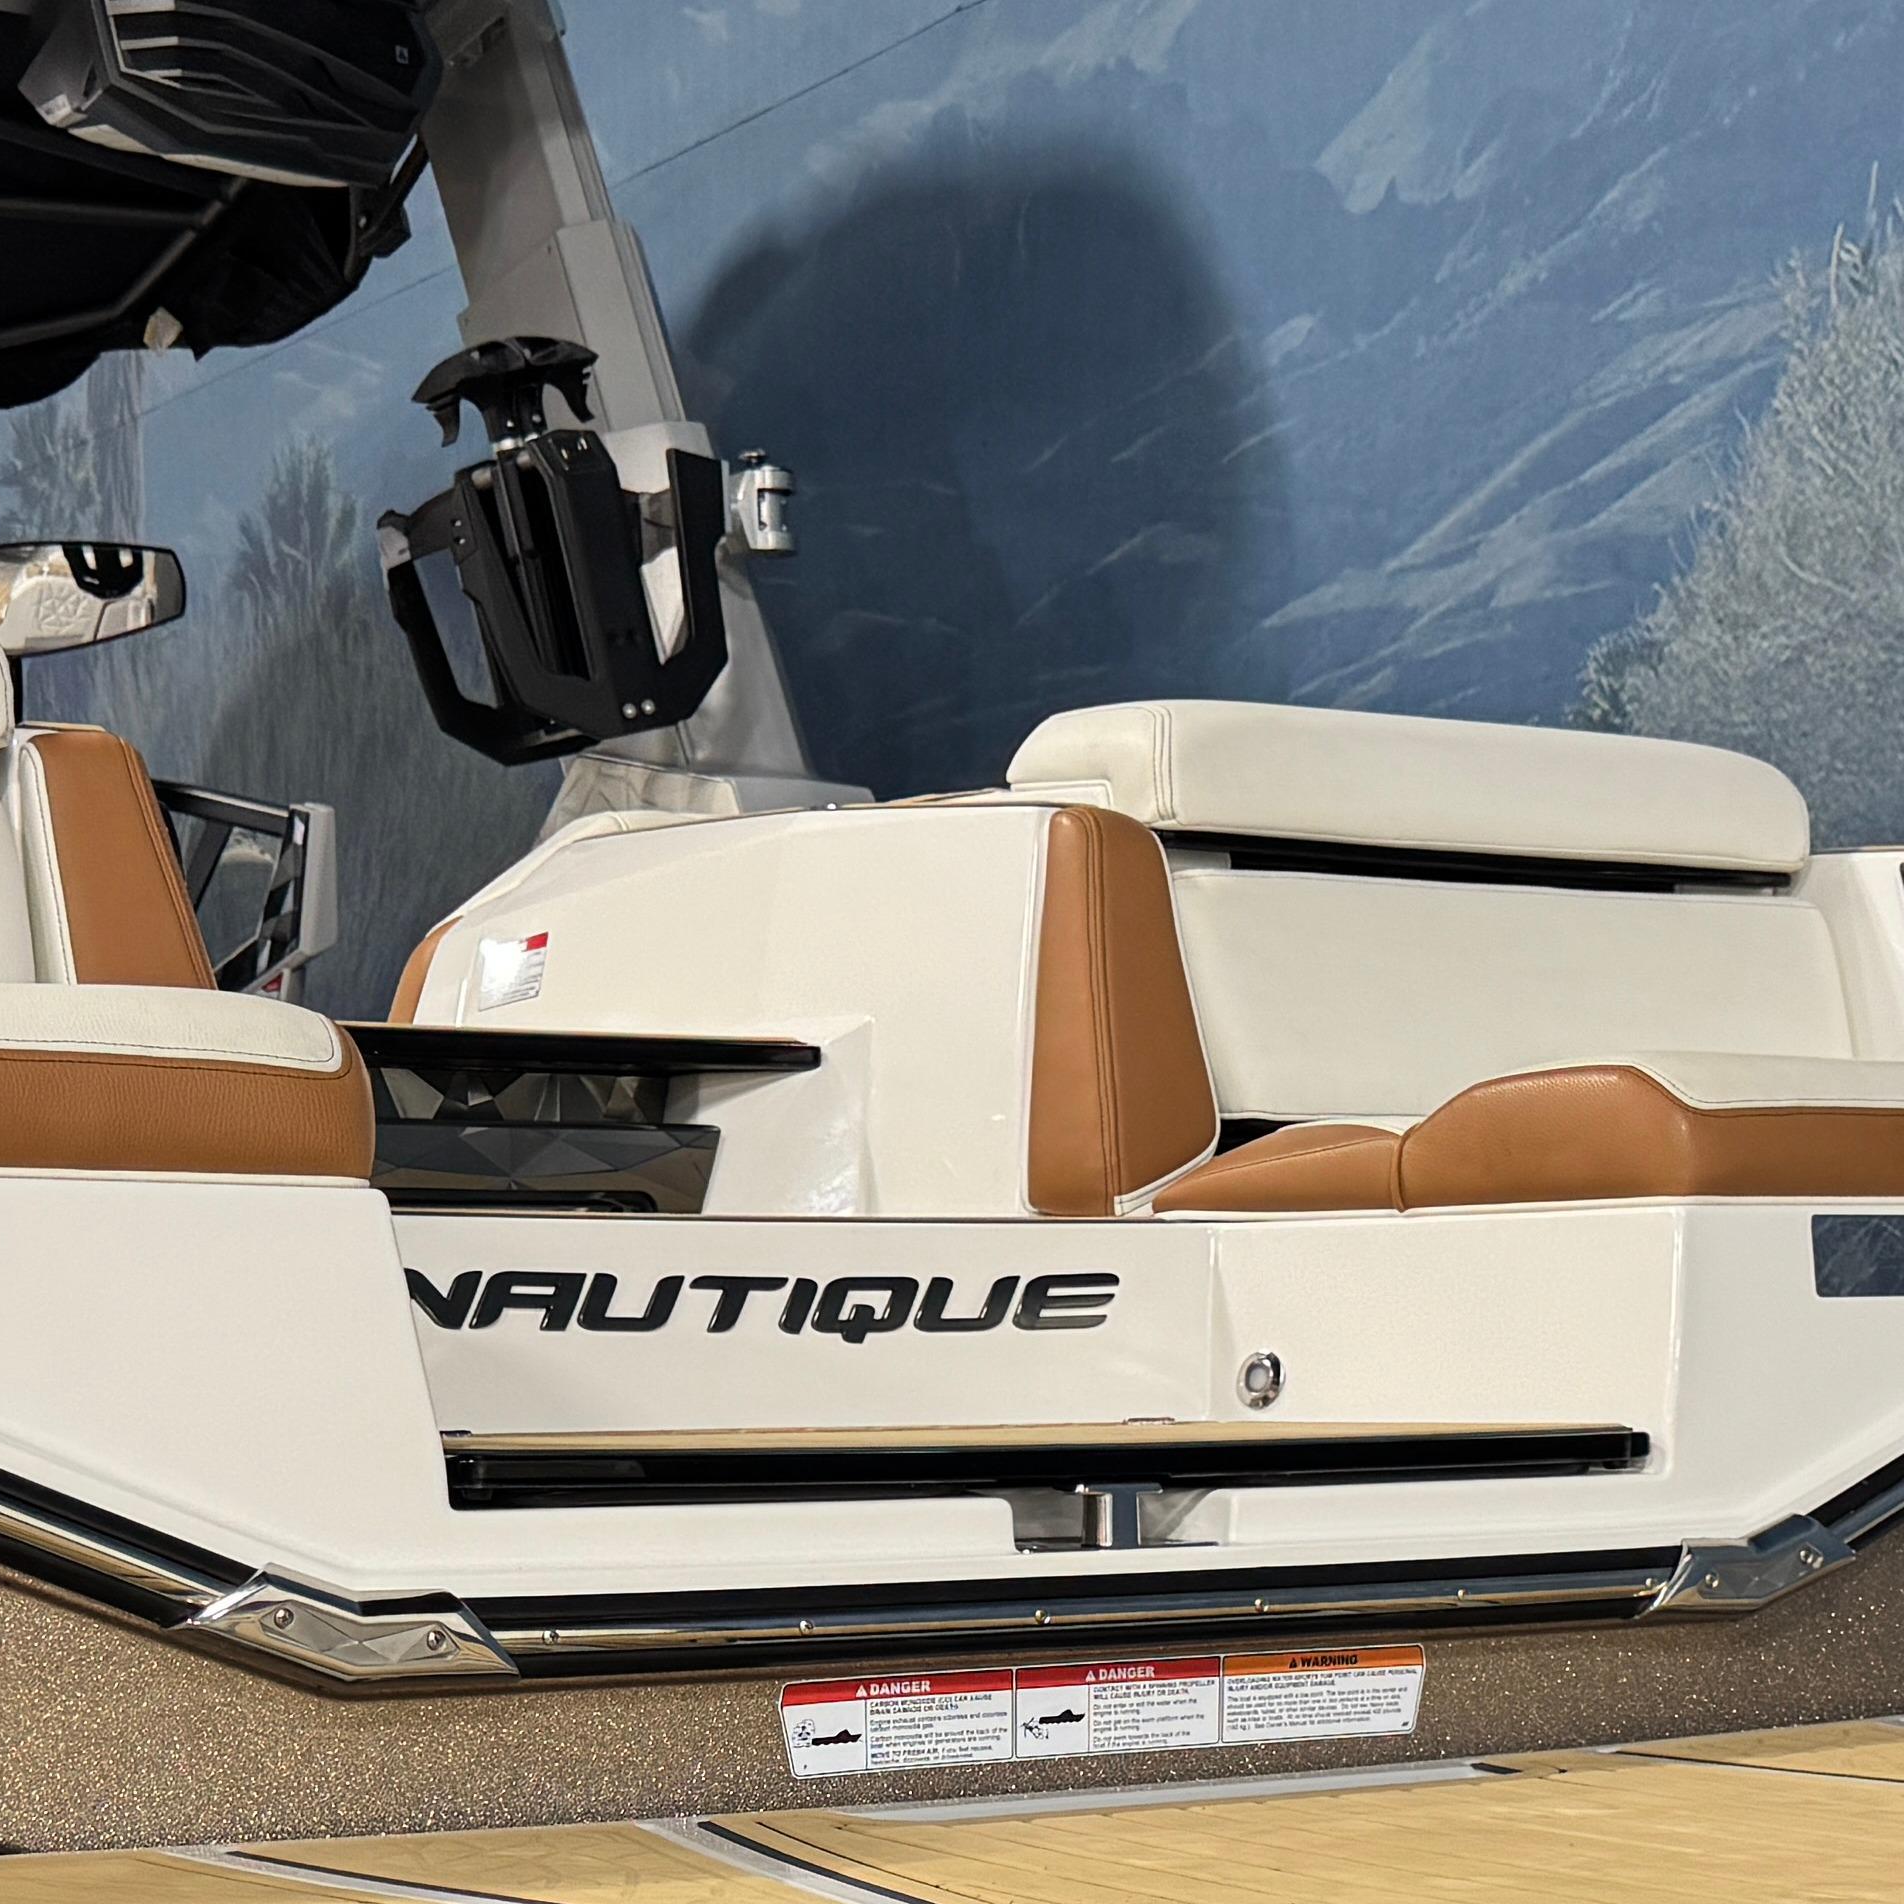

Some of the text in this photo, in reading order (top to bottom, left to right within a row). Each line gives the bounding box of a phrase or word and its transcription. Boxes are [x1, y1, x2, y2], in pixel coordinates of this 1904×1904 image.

[404, 1268, 1120, 1343] NAUTIQUE
[1301, 1654, 1358, 1668] WARNING
[1099, 1666, 1155, 1681] DANGER
[870, 1680, 931, 1697] DANGER
